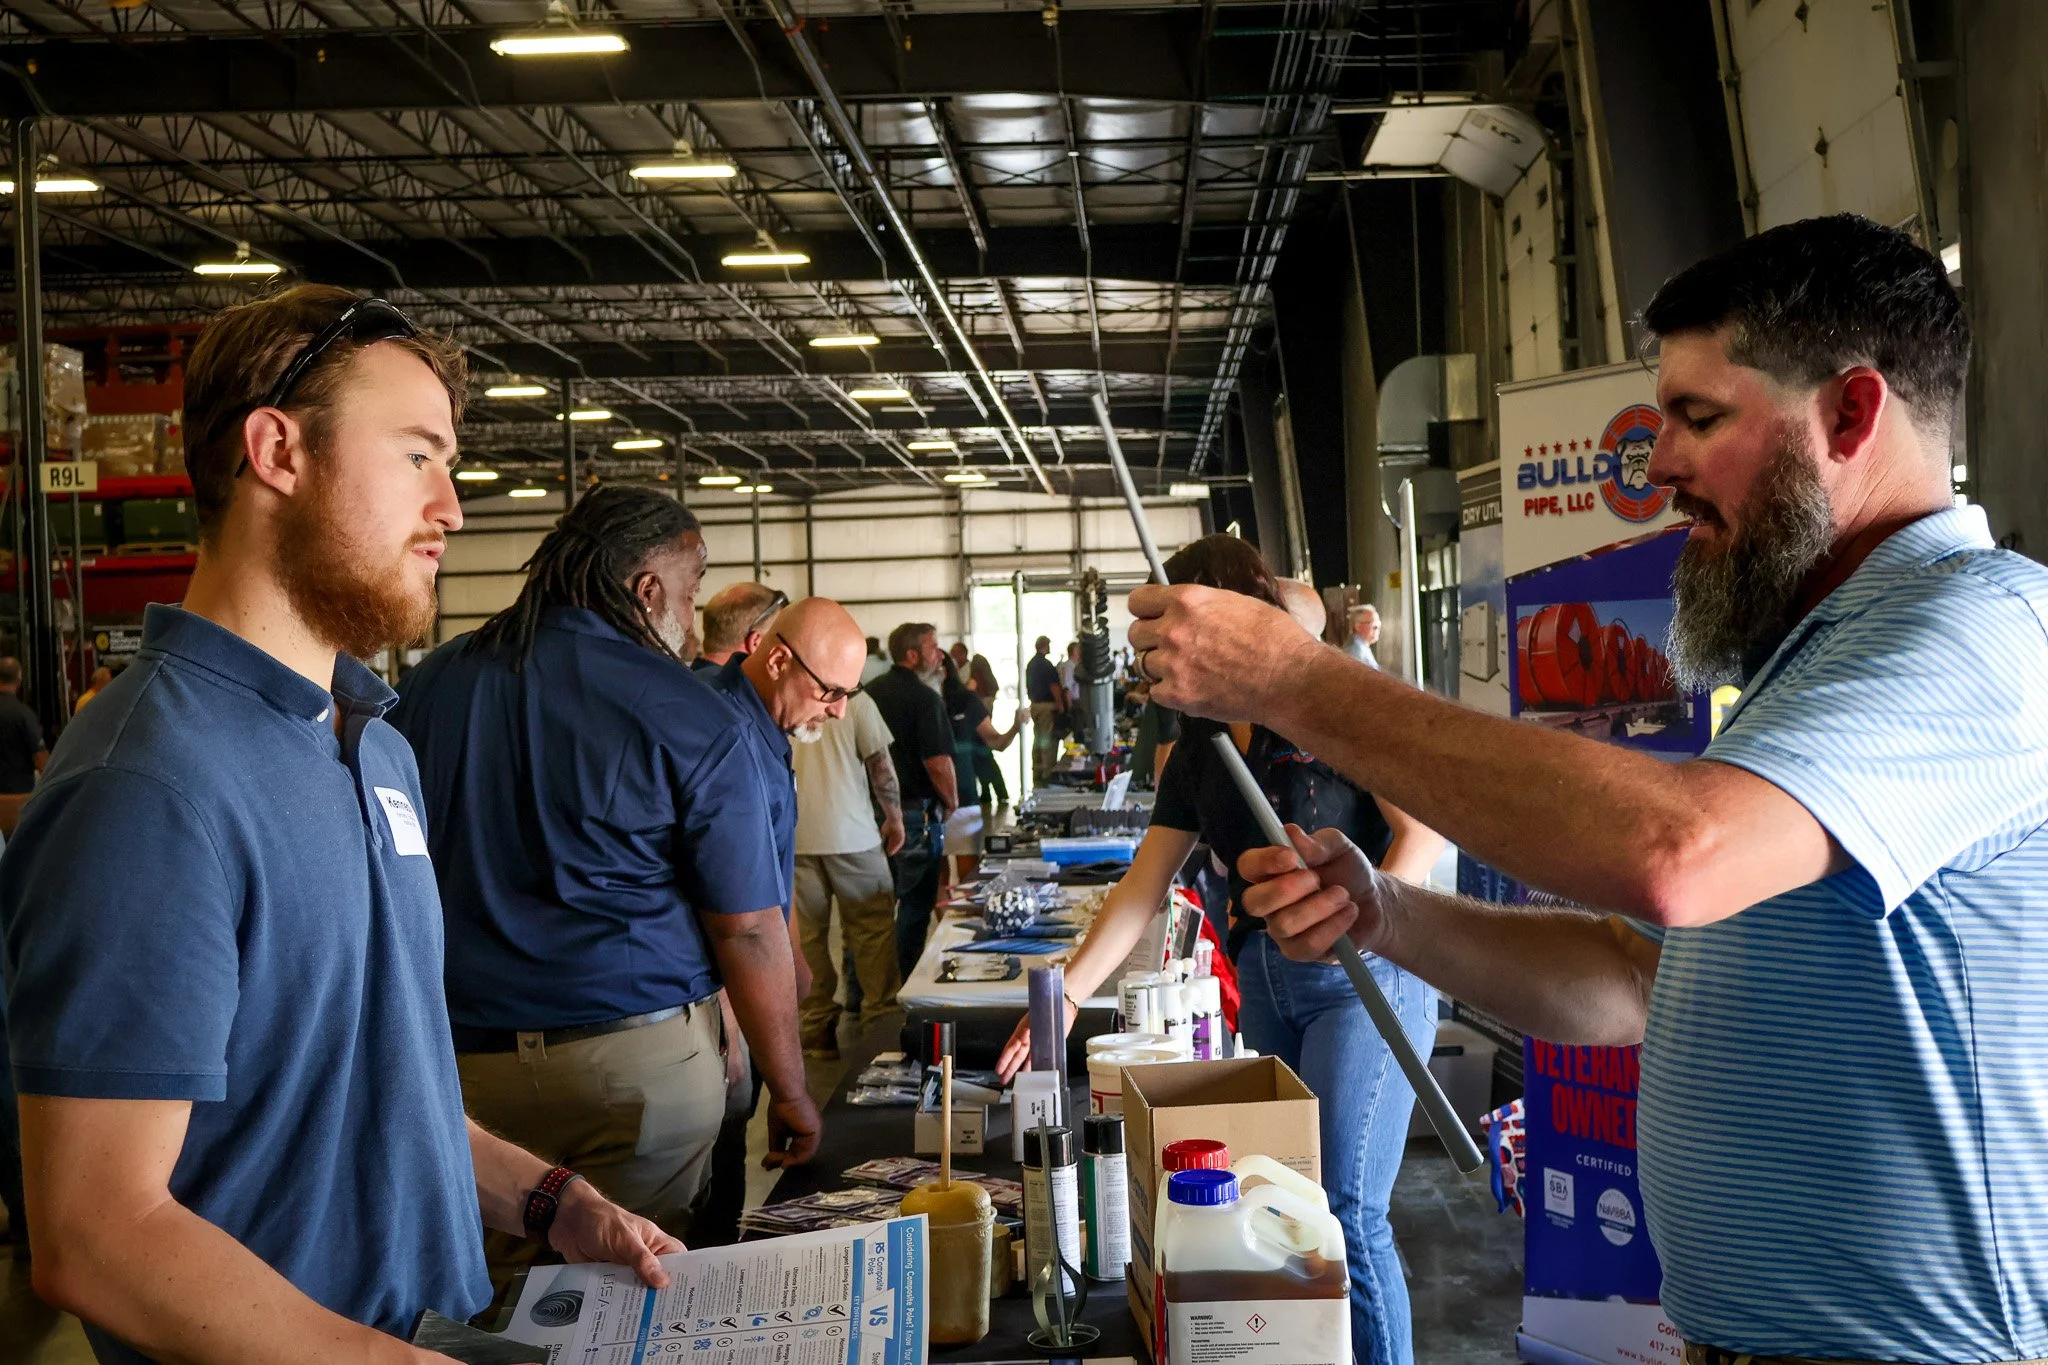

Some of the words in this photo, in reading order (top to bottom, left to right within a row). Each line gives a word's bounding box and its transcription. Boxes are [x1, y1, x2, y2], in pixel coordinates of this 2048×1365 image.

[50, 466, 85, 487] R9L
[1517, 452, 1614, 490] BULLD
[1462, 503, 1481, 525] DRY
[1482, 500, 1502, 522] UTIL
[1524, 495, 1563, 516] PIPE,
[1567, 492, 1595, 512] LLC
[1576, 1153, 1632, 1177] CERTIFIED
[1549, 1179, 1568, 1196] SBA
[875, 1241, 885, 1254] RS
[905, 1226, 914, 1270] Considering
[867, 1257, 876, 1276] Poles
[875, 1256, 885, 1291] Composite
[905, 1270, 915, 1306] Composite
[868, 1304, 888, 1327] VS
[905, 1306, 914, 1328] Poles?
[905, 1329, 914, 1346] Know
[1657, 1322, 1682, 1339] Con
[904, 1346, 913, 1362] Your
[1649, 1339, 1681, 1357] 417-23
